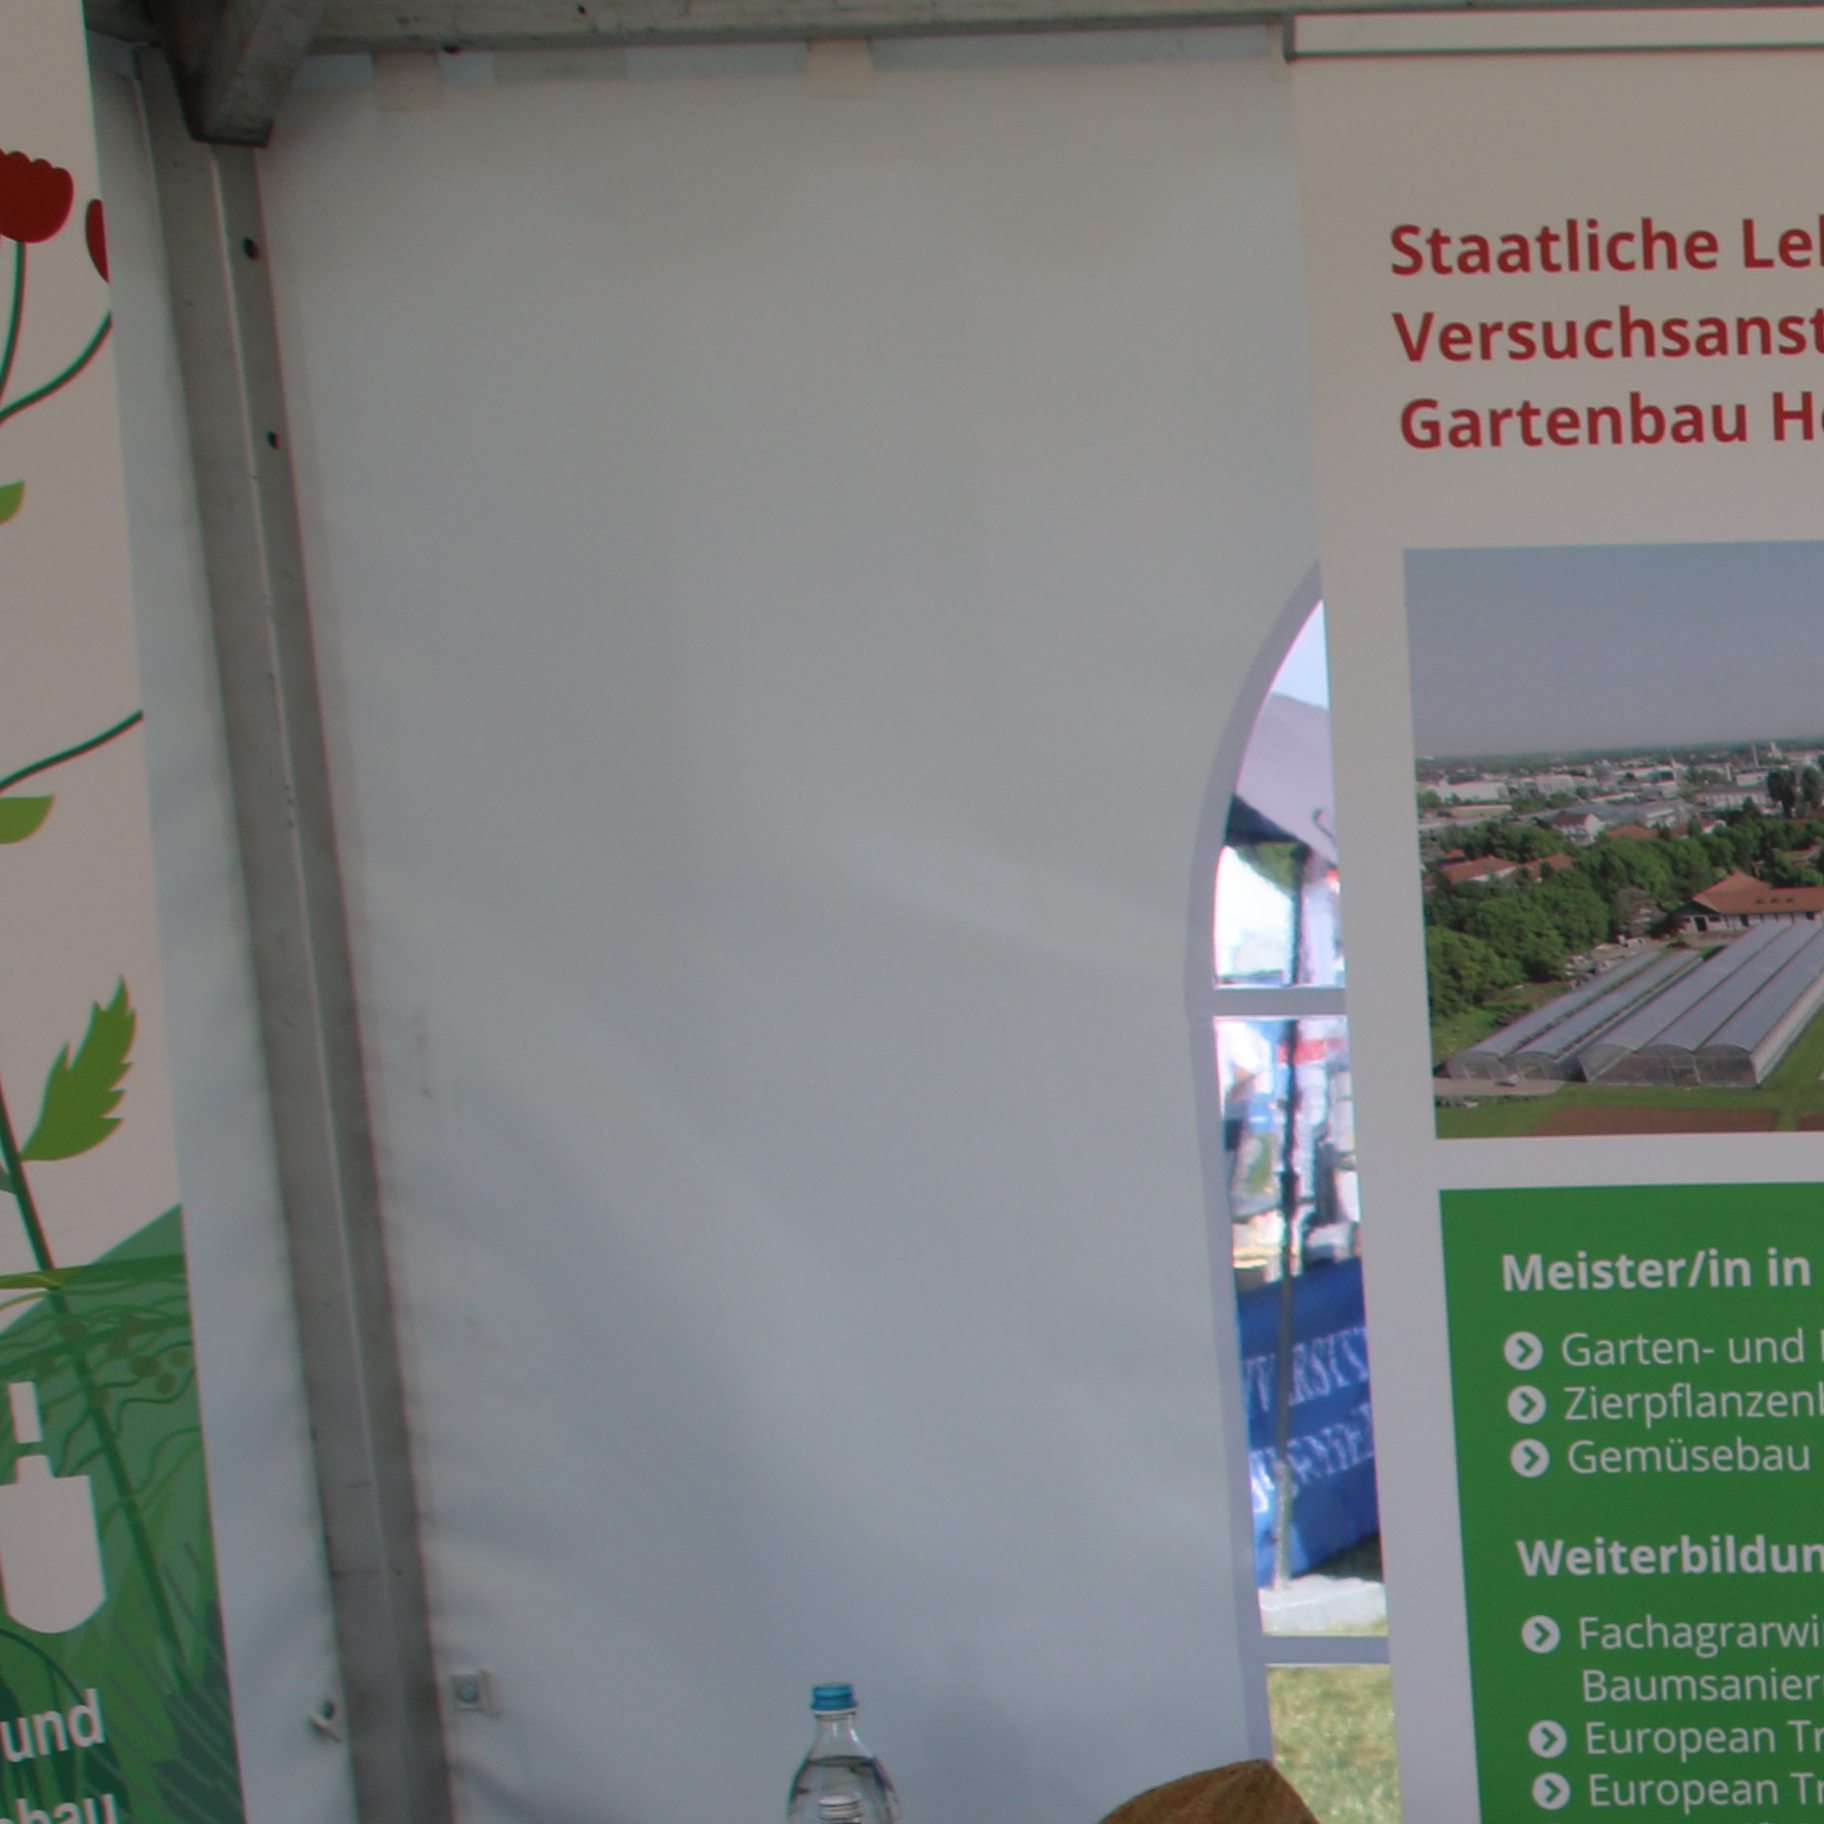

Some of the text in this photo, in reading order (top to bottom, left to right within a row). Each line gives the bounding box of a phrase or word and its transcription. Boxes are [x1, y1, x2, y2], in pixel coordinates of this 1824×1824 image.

[1391, 217, 1718, 276] Staatliche
[1401, 392, 1747, 449] Gartenbau
[1502, 1248, 1751, 1291] Meister/in
[1768, 1247, 1810, 1286] in
[1561, 1332, 1714, 1366] Garten-
[1728, 1328, 1804, 1364] und
[1568, 1436, 1810, 1474] Gemüsebau
[0, 1688, 106, 1762] und
[1586, 1721, 1775, 1763] European
[1589, 1773, 1778, 1815] European
